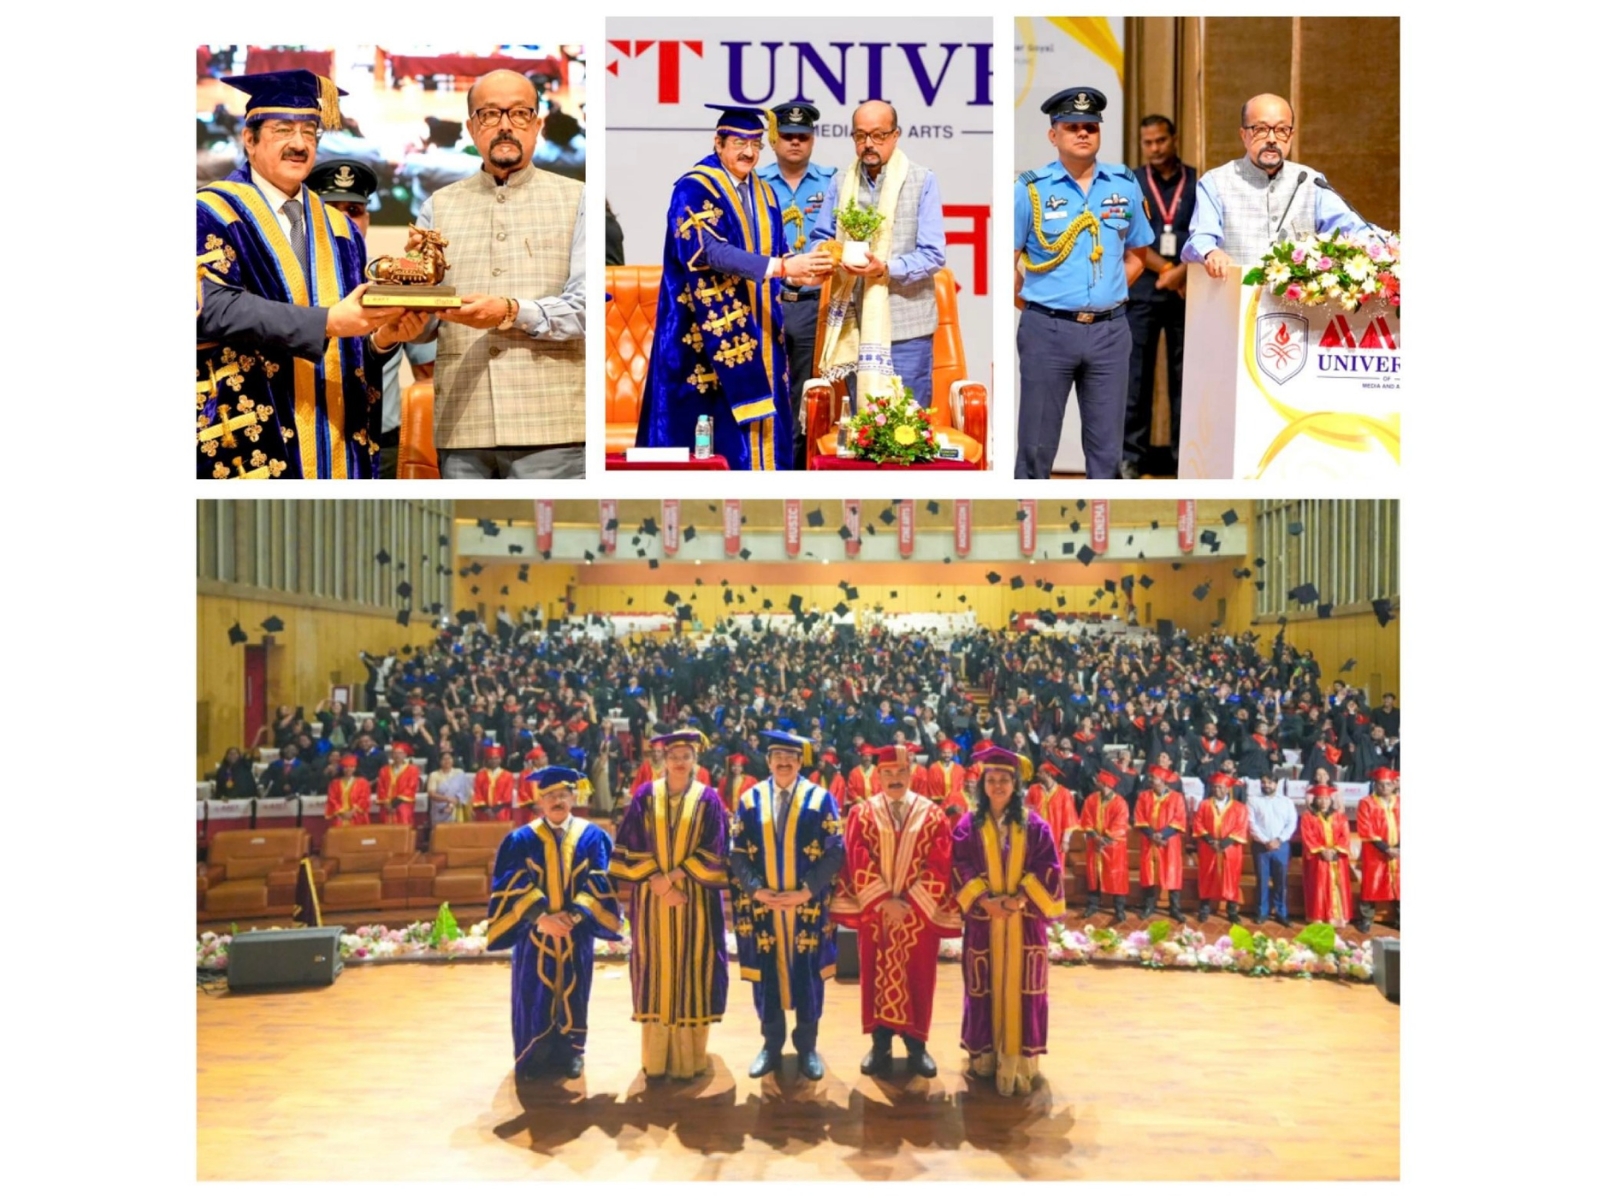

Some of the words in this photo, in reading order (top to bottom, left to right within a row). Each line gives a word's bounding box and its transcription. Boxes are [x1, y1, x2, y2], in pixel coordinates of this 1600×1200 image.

[908, 124, 953, 139] ARTS
[788, 507, 798, 544] MUSIC
[1094, 504, 1105, 542] CINEMA
